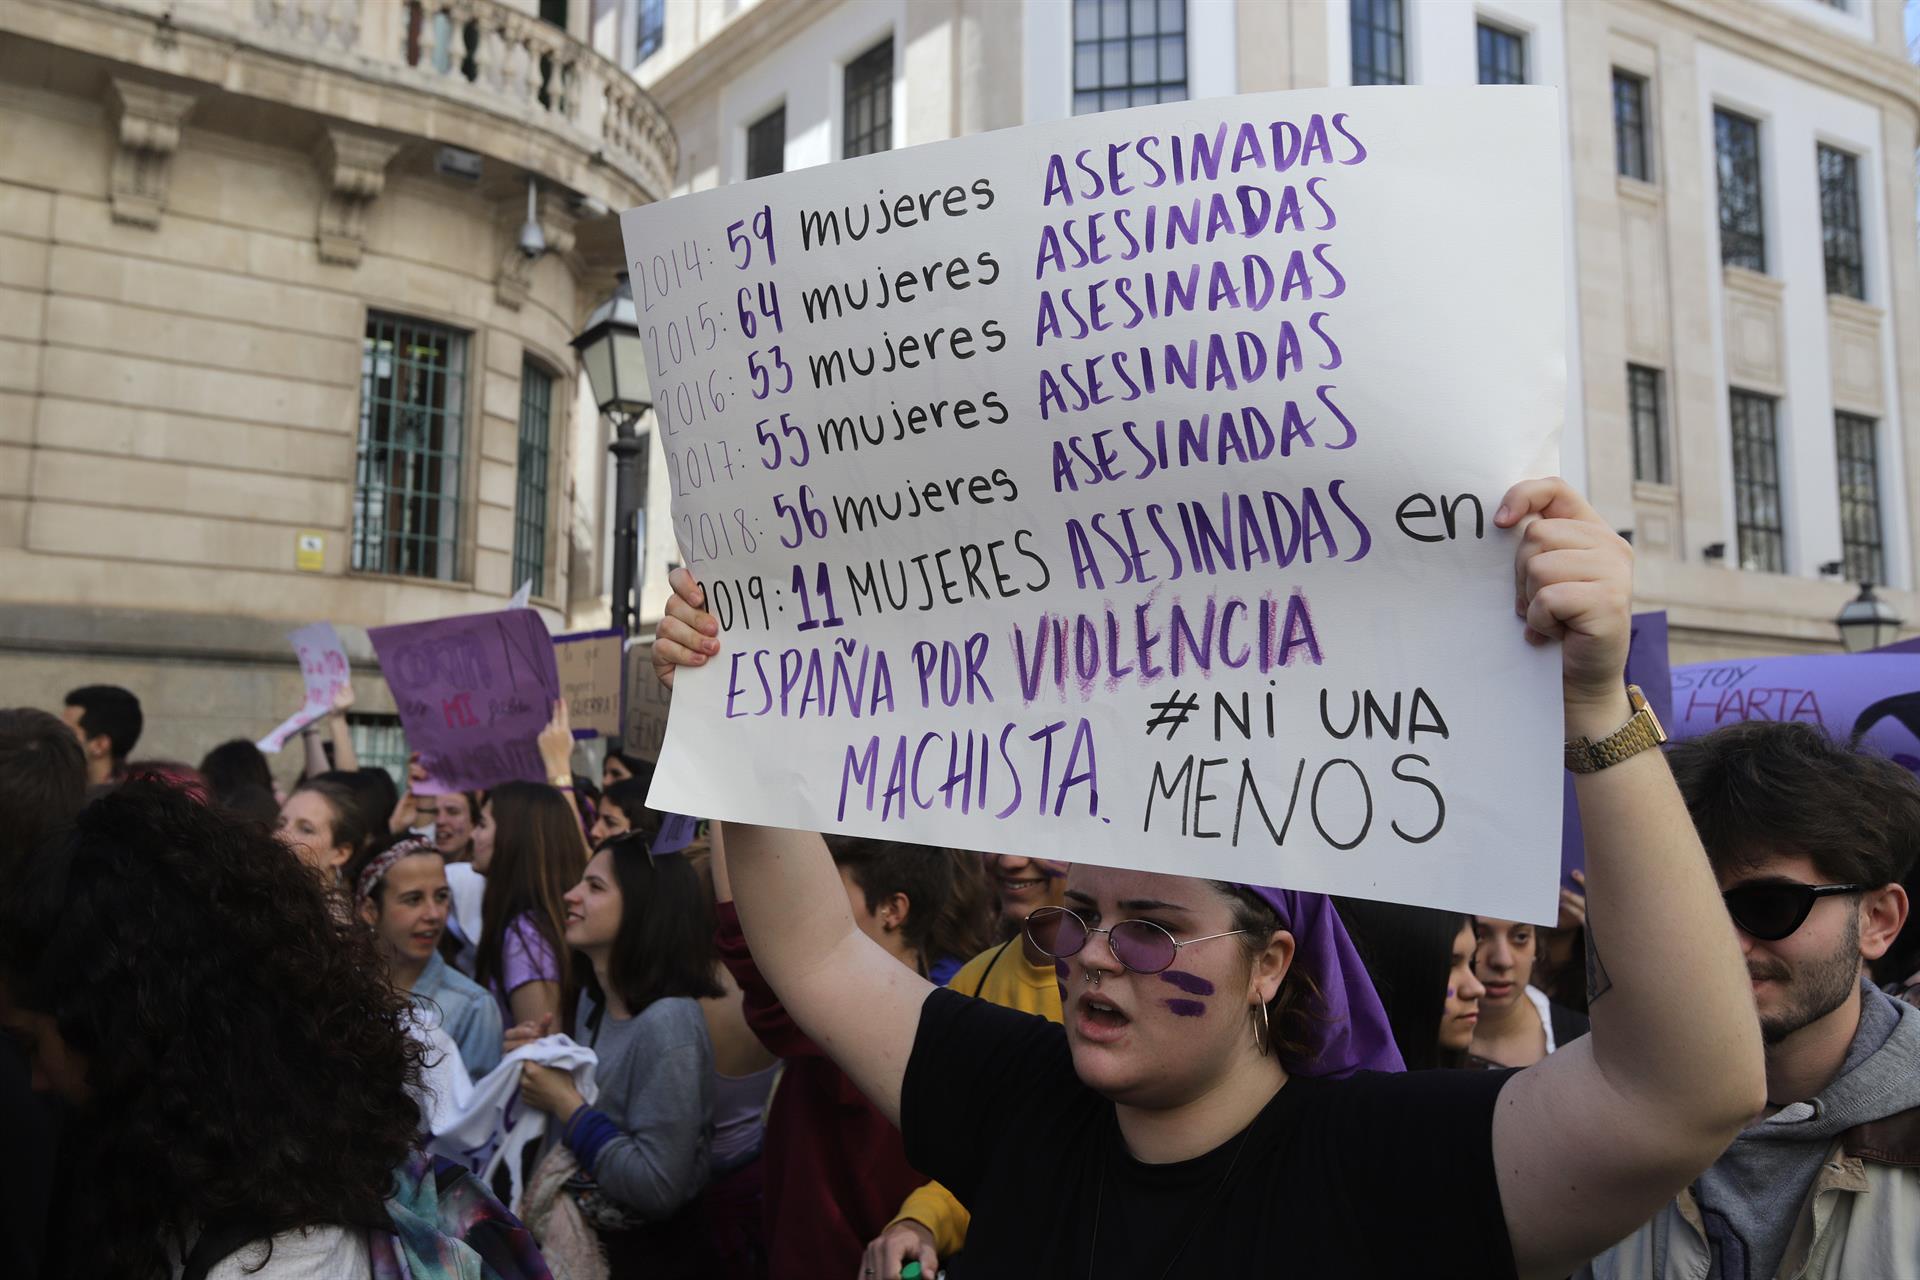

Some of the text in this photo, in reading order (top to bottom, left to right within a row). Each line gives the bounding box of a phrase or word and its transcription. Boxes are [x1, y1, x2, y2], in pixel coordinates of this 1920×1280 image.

[635, 113, 1367, 312] 2014: 59 mujeres ASESINADAS
[649, 177, 1337, 376] 2015: 64 mujeres ASESINADAS
[660, 243, 1346, 436] 2016: 53 mujeres ASESINADAS
[671, 312, 1343, 497] 2017: 55 mujeres ASESINADAS
[683, 385, 1358, 564] 2018: 56 mujeres ASESINADAS
[791, 562, 844, 631] 11
[846, 530, 1050, 616] MUJERES
[1065, 479, 1372, 590] ASESINADAS
[1396, 493, 1484, 542] en
[725, 637, 895, 719] ESPAÑA
[912, 632, 995, 708] POR
[1010, 588, 1324, 706] VIOLENCIA
[1320, 687, 1449, 744] UNA
[1672, 665, 1757, 691] STOY
[1685, 688, 1823, 723] HARTA
[837, 717, 1110, 823] MACHISTA.
[1144, 754, 1445, 850] MENOS
